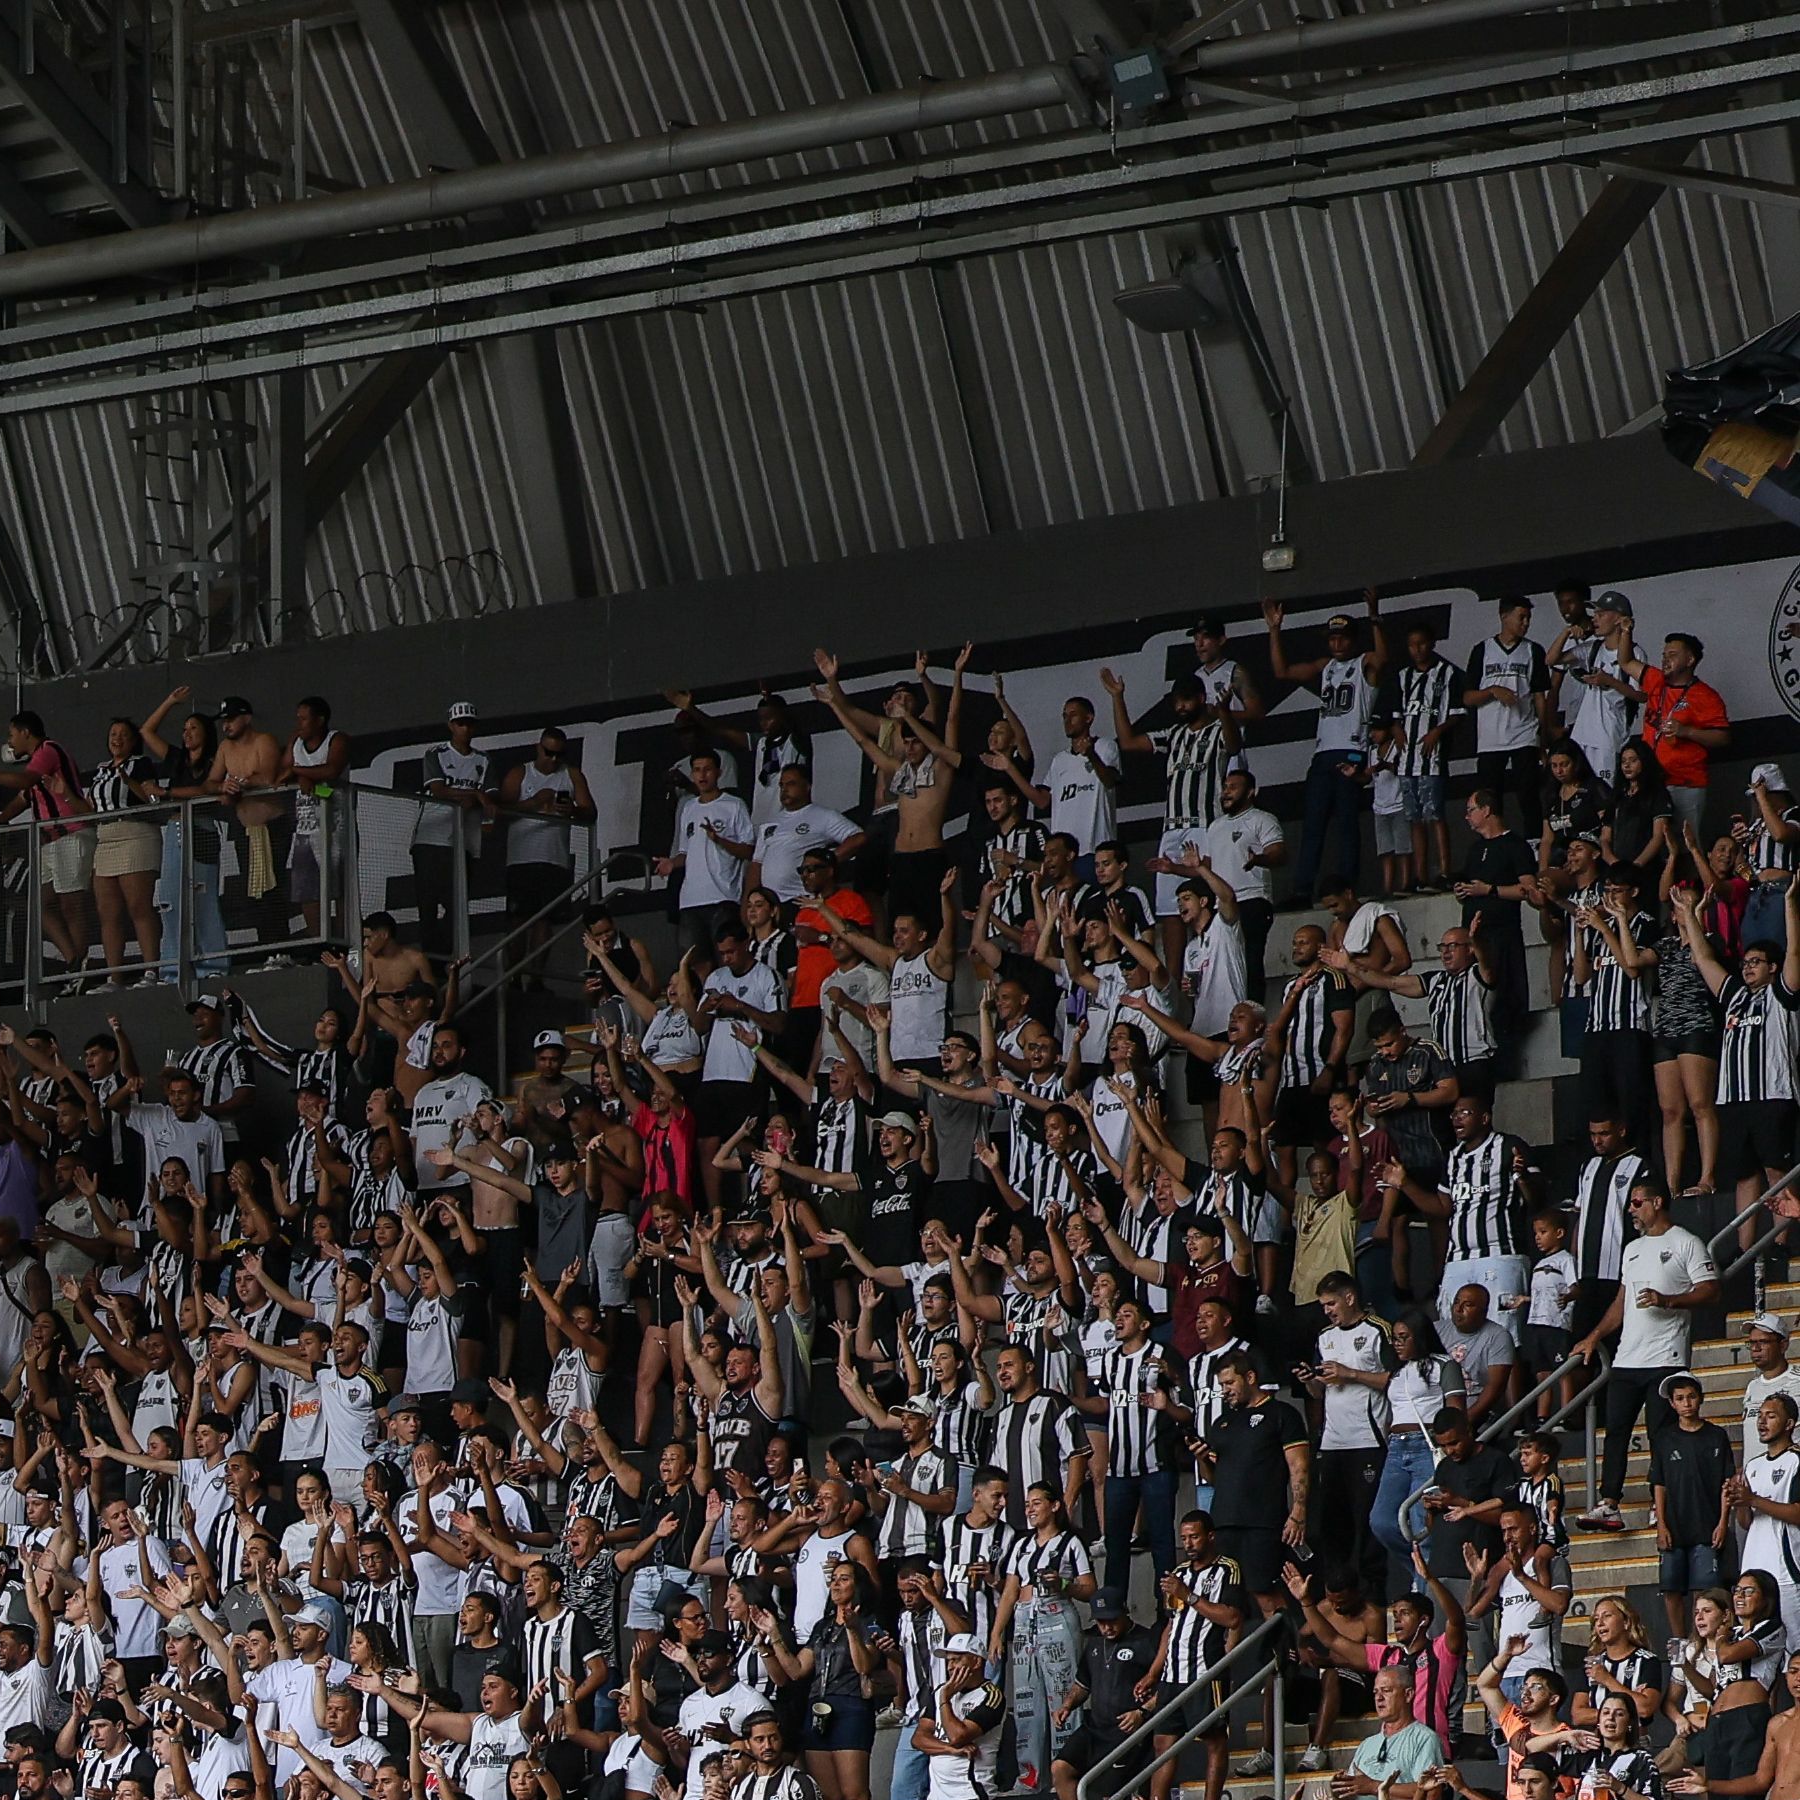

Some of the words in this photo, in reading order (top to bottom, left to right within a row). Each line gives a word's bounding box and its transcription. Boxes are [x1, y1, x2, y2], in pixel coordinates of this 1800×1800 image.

[1061, 783, 1095, 802] H2bet
[416, 1105, 444, 1118] MRV
[1452, 1184, 1490, 1200] H2bet
[871, 1193, 911, 1218] Coca-Cola
[1012, 1319, 1045, 1332] BETANO
[1086, 1347, 1113, 1358] BETAN
[1113, 1389, 1140, 1407] H2b
[1197, 1388, 1224, 1406] H2be
[290, 1399, 321, 1420] BMG
[1503, 1593, 1536, 1607] BETAN
[687, 1729, 713, 1747] H2b
